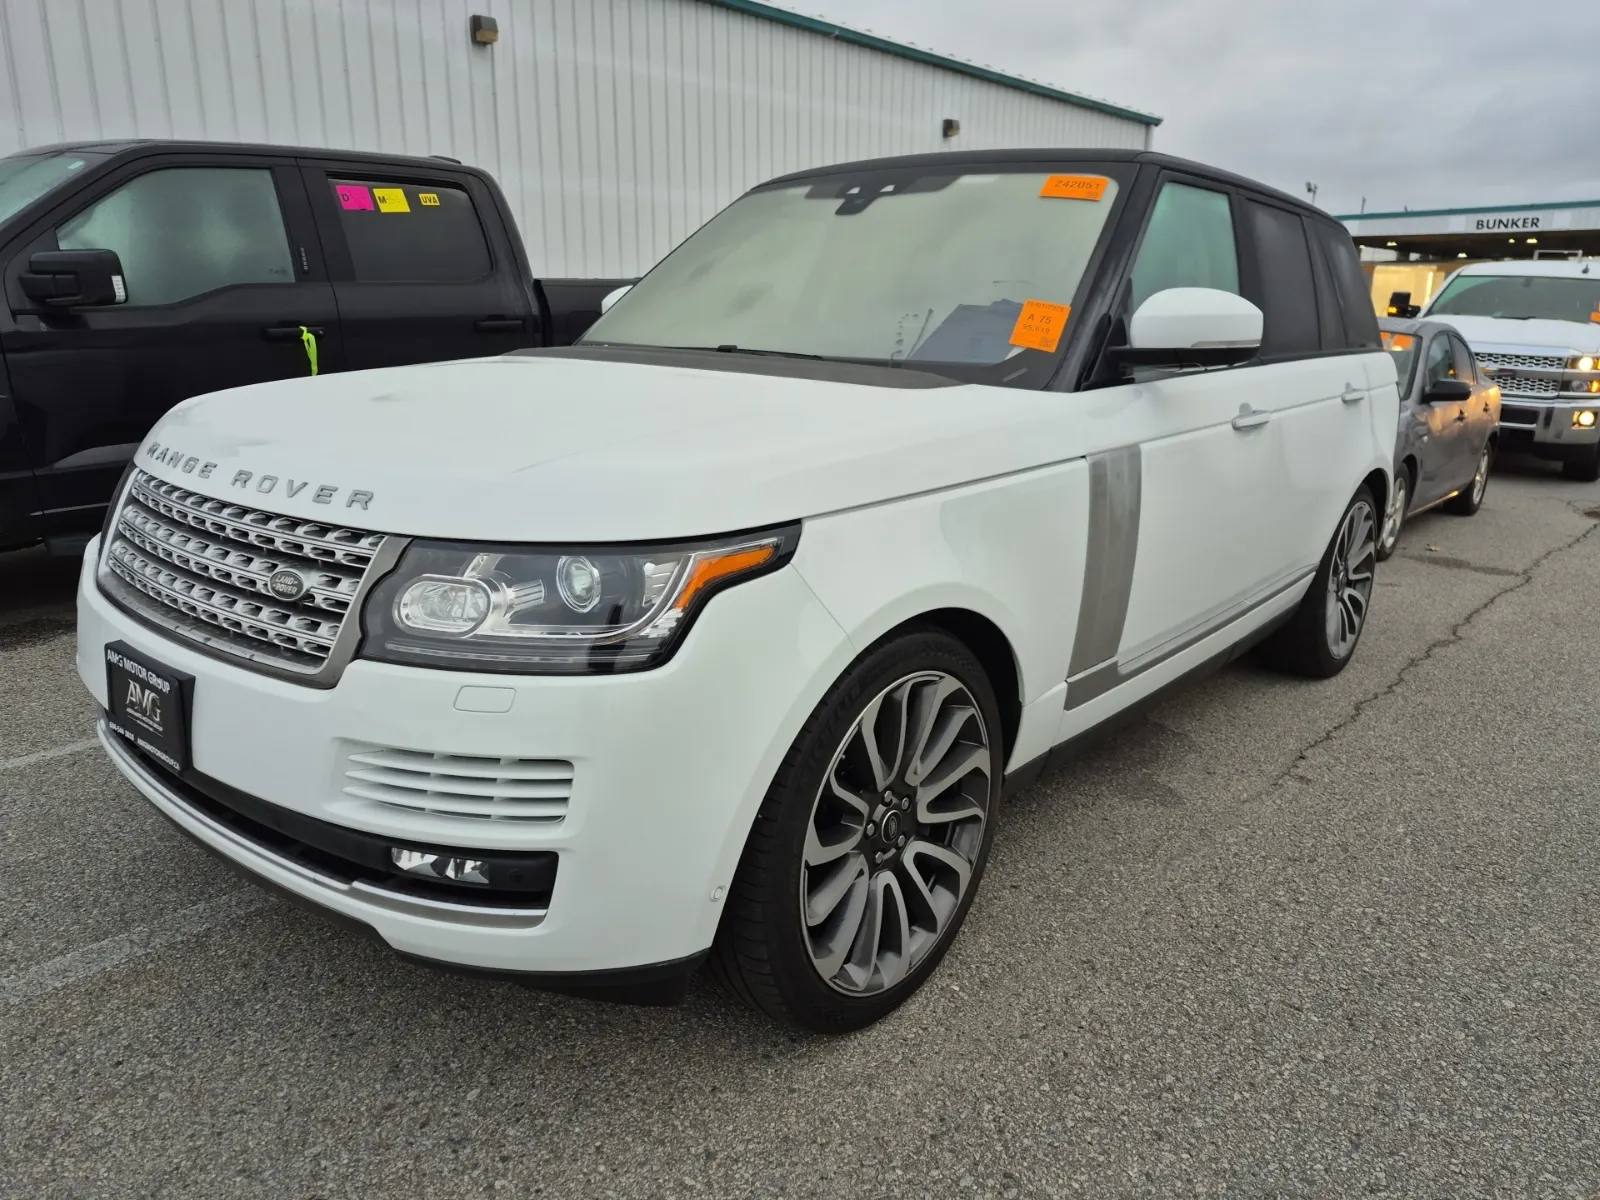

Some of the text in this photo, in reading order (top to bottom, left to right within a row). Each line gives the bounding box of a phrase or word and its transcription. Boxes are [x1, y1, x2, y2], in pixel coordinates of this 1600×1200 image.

[1054, 180, 1100, 189] 242051
[421, 196, 438, 205] UVA
[1475, 217, 1540, 230] BUNKER
[1027, 313, 1052, 325] A 75
[146, 441, 374, 511] RANGE ROVER
[275, 574, 295, 585] LAND
[274, 583, 298, 595] ROVER
[123, 658, 148, 681] MOTOR
[147, 671, 171, 694] GROUP
[125, 679, 162, 722] AMG
